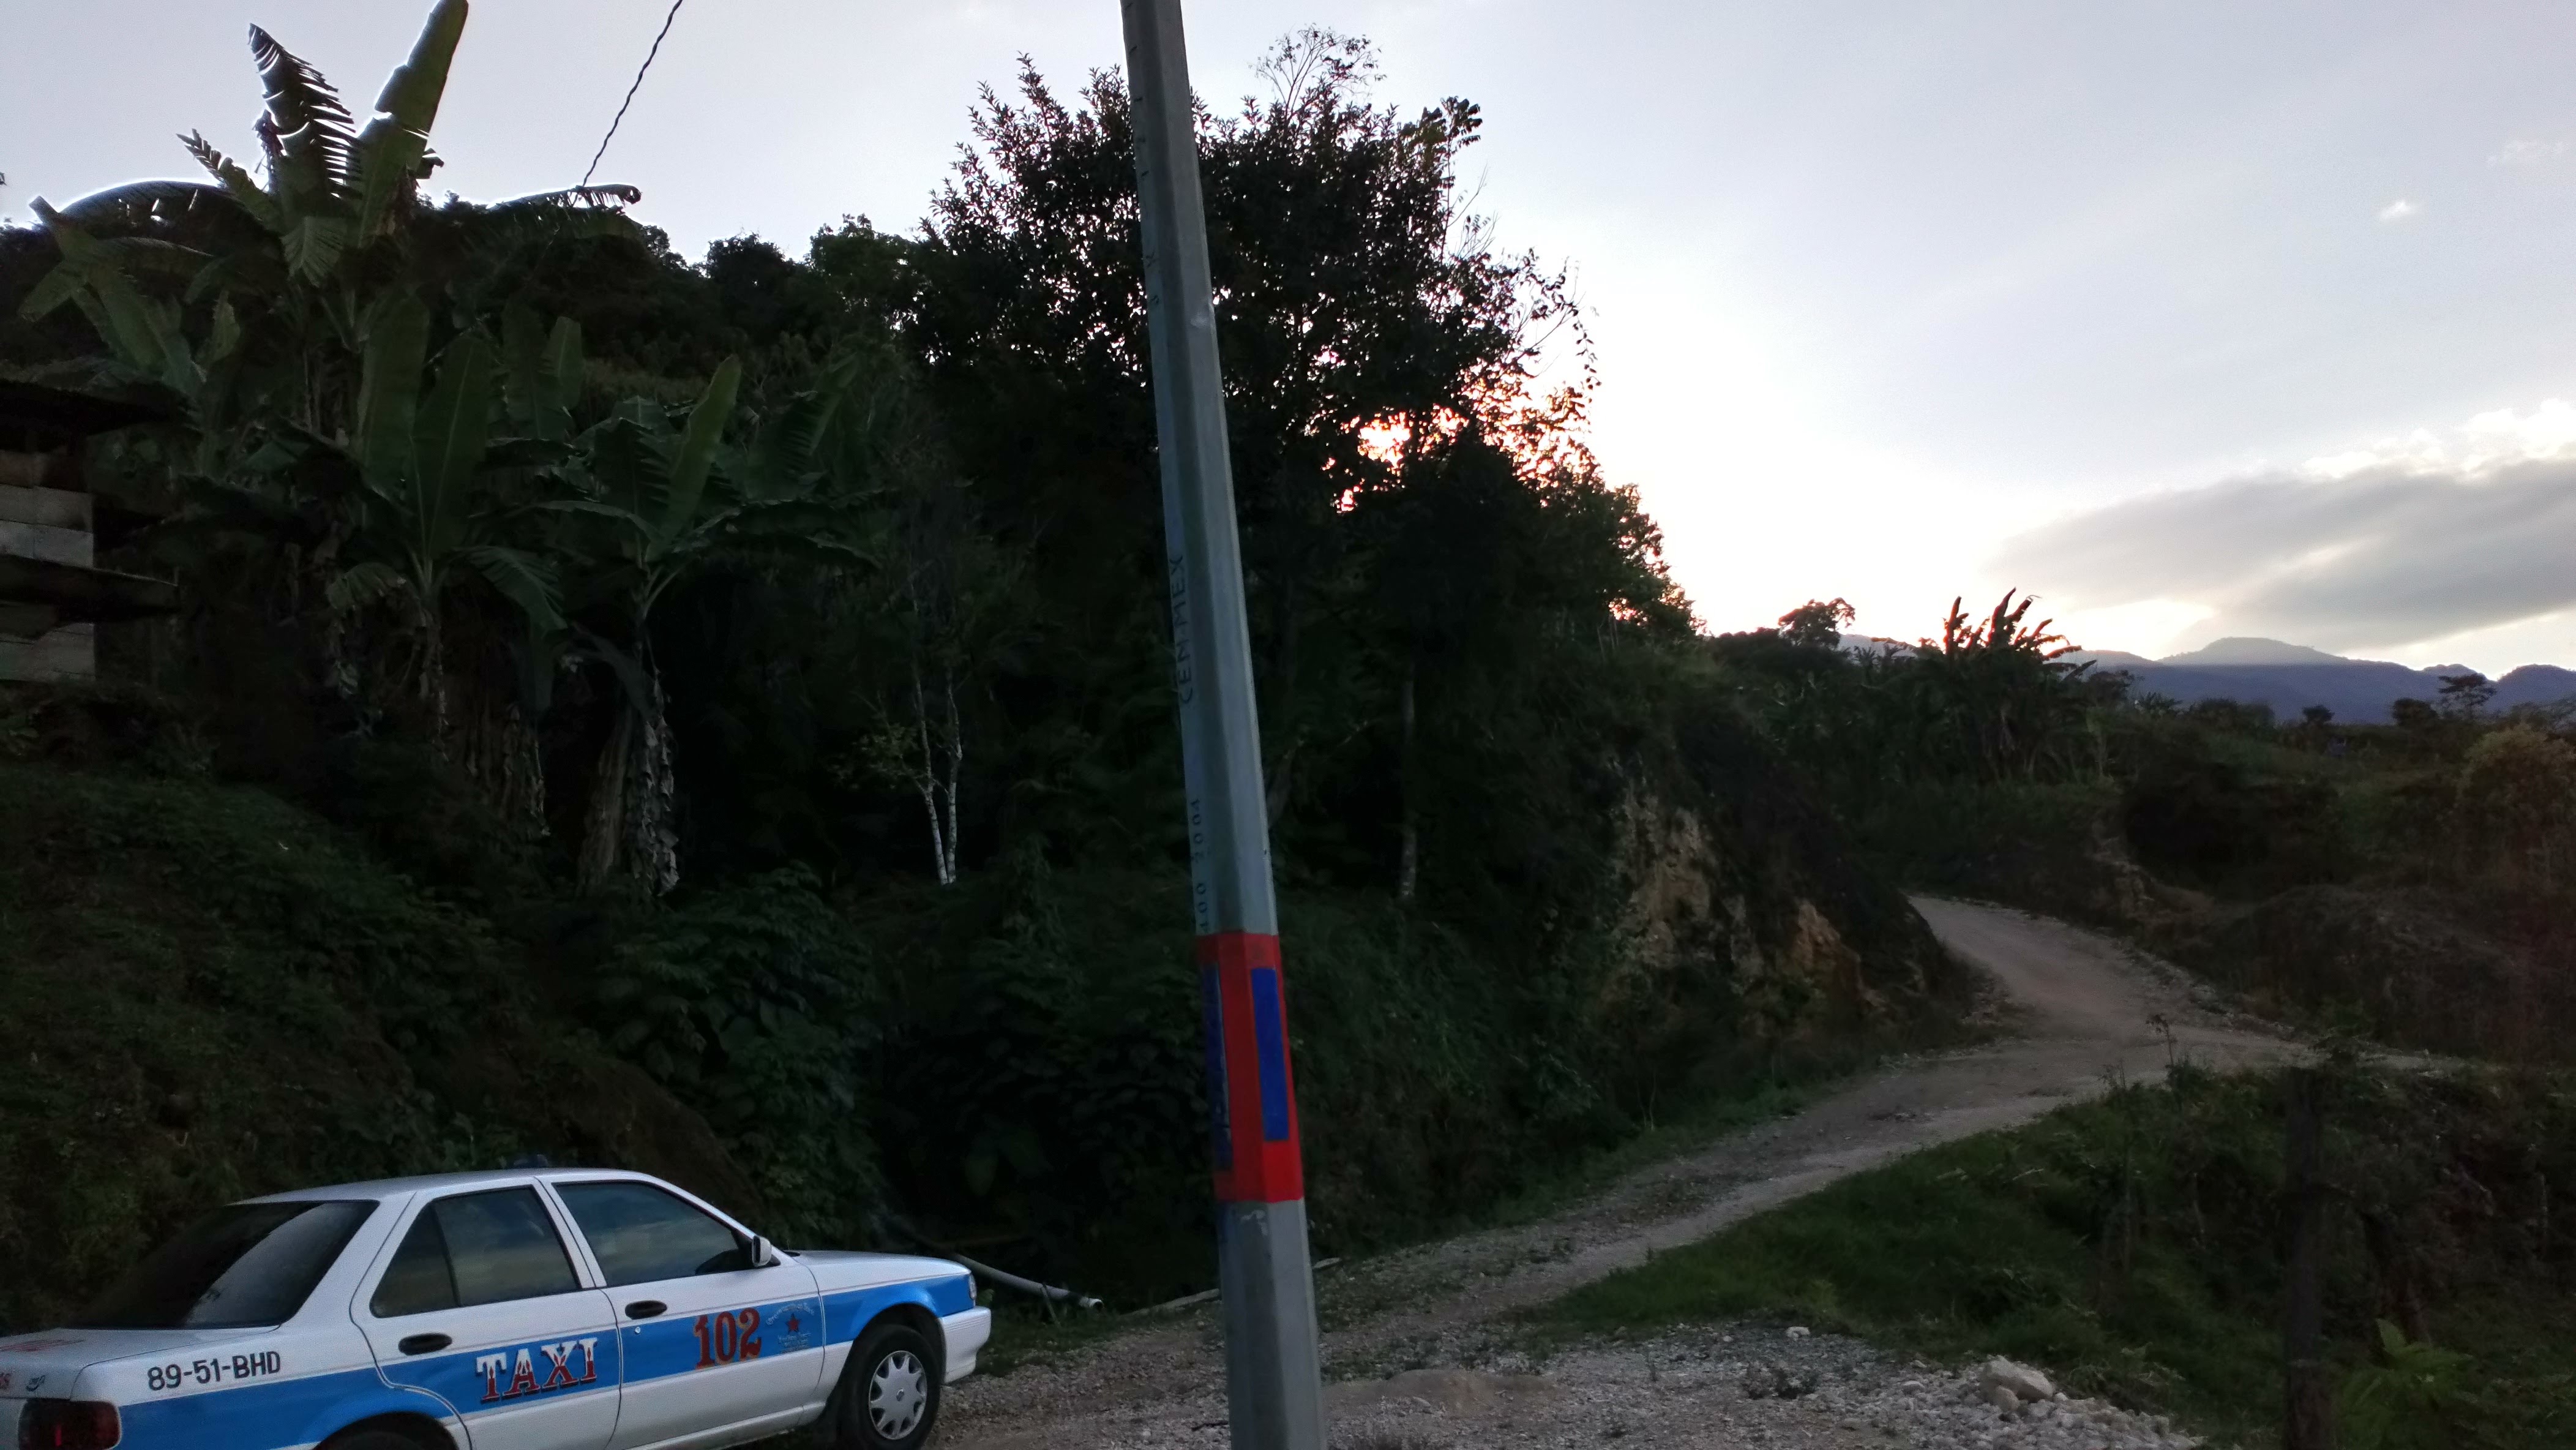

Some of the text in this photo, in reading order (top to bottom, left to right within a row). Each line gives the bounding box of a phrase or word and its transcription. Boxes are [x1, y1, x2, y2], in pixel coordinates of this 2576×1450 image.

[476, 1337, 598, 1402] TAXI
[694, 1307, 762, 1370] 102
[148, 1351, 281, 1391] 89-51-BHD
